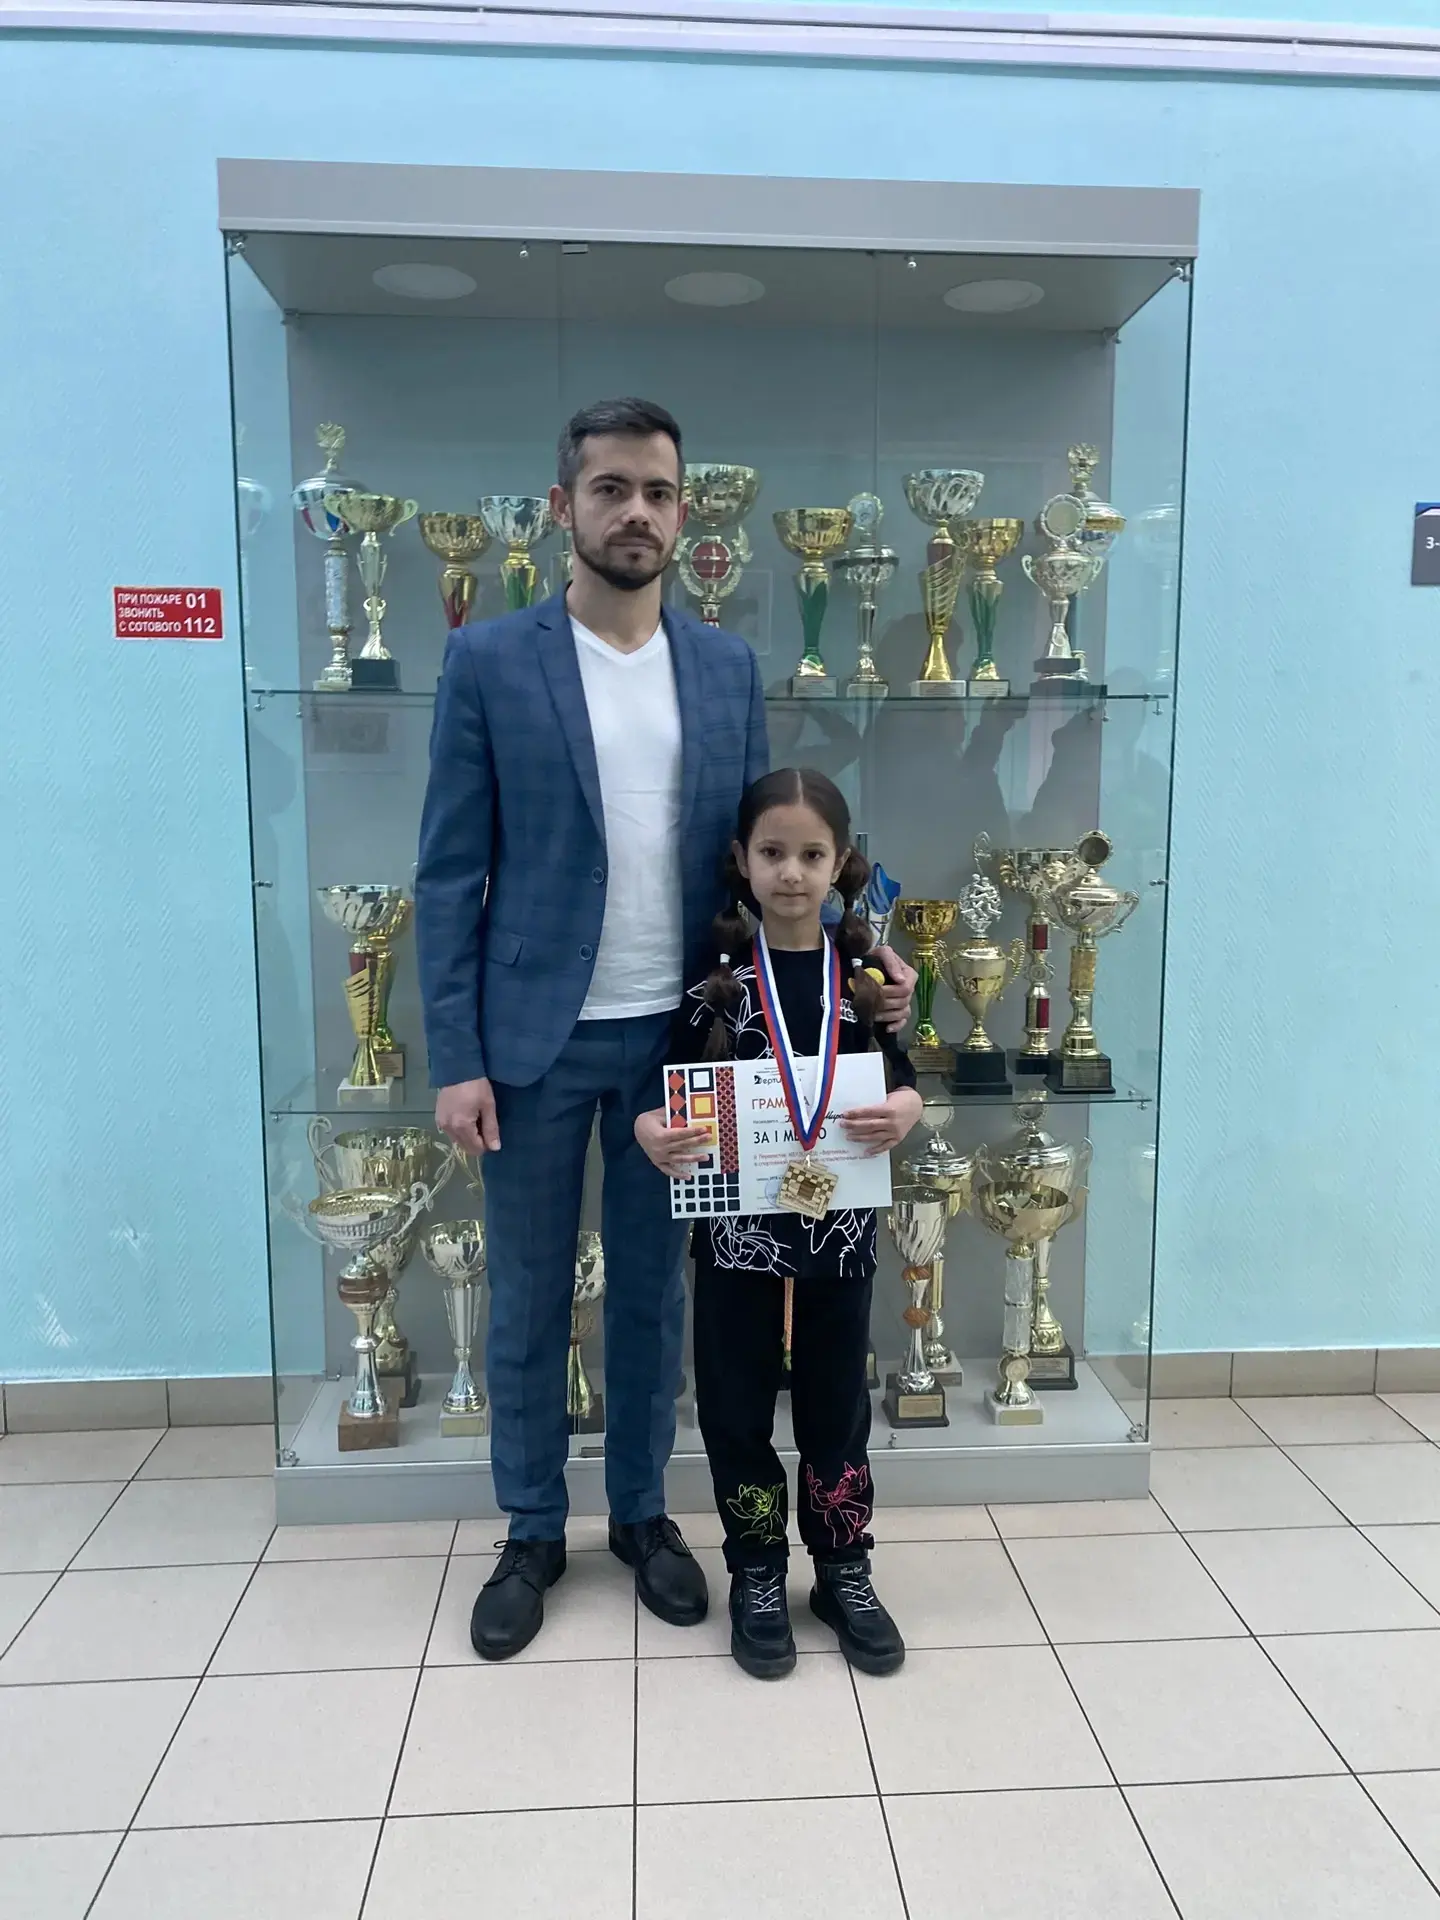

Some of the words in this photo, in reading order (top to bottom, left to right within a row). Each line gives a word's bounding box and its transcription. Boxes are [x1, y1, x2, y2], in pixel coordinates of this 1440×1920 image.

[117, 593, 138, 605] ПРИ
[139, 593, 182, 605] ПОЖАРЕ
[185, 592, 207, 609] 01
[118, 607, 164, 618] ЗВОНИТЬ
[119, 621, 127, 632] С
[128, 621, 182, 632] СОТОВОГО
[184, 616, 216, 633] 112
[753, 1131, 770, 1144] ЗА
